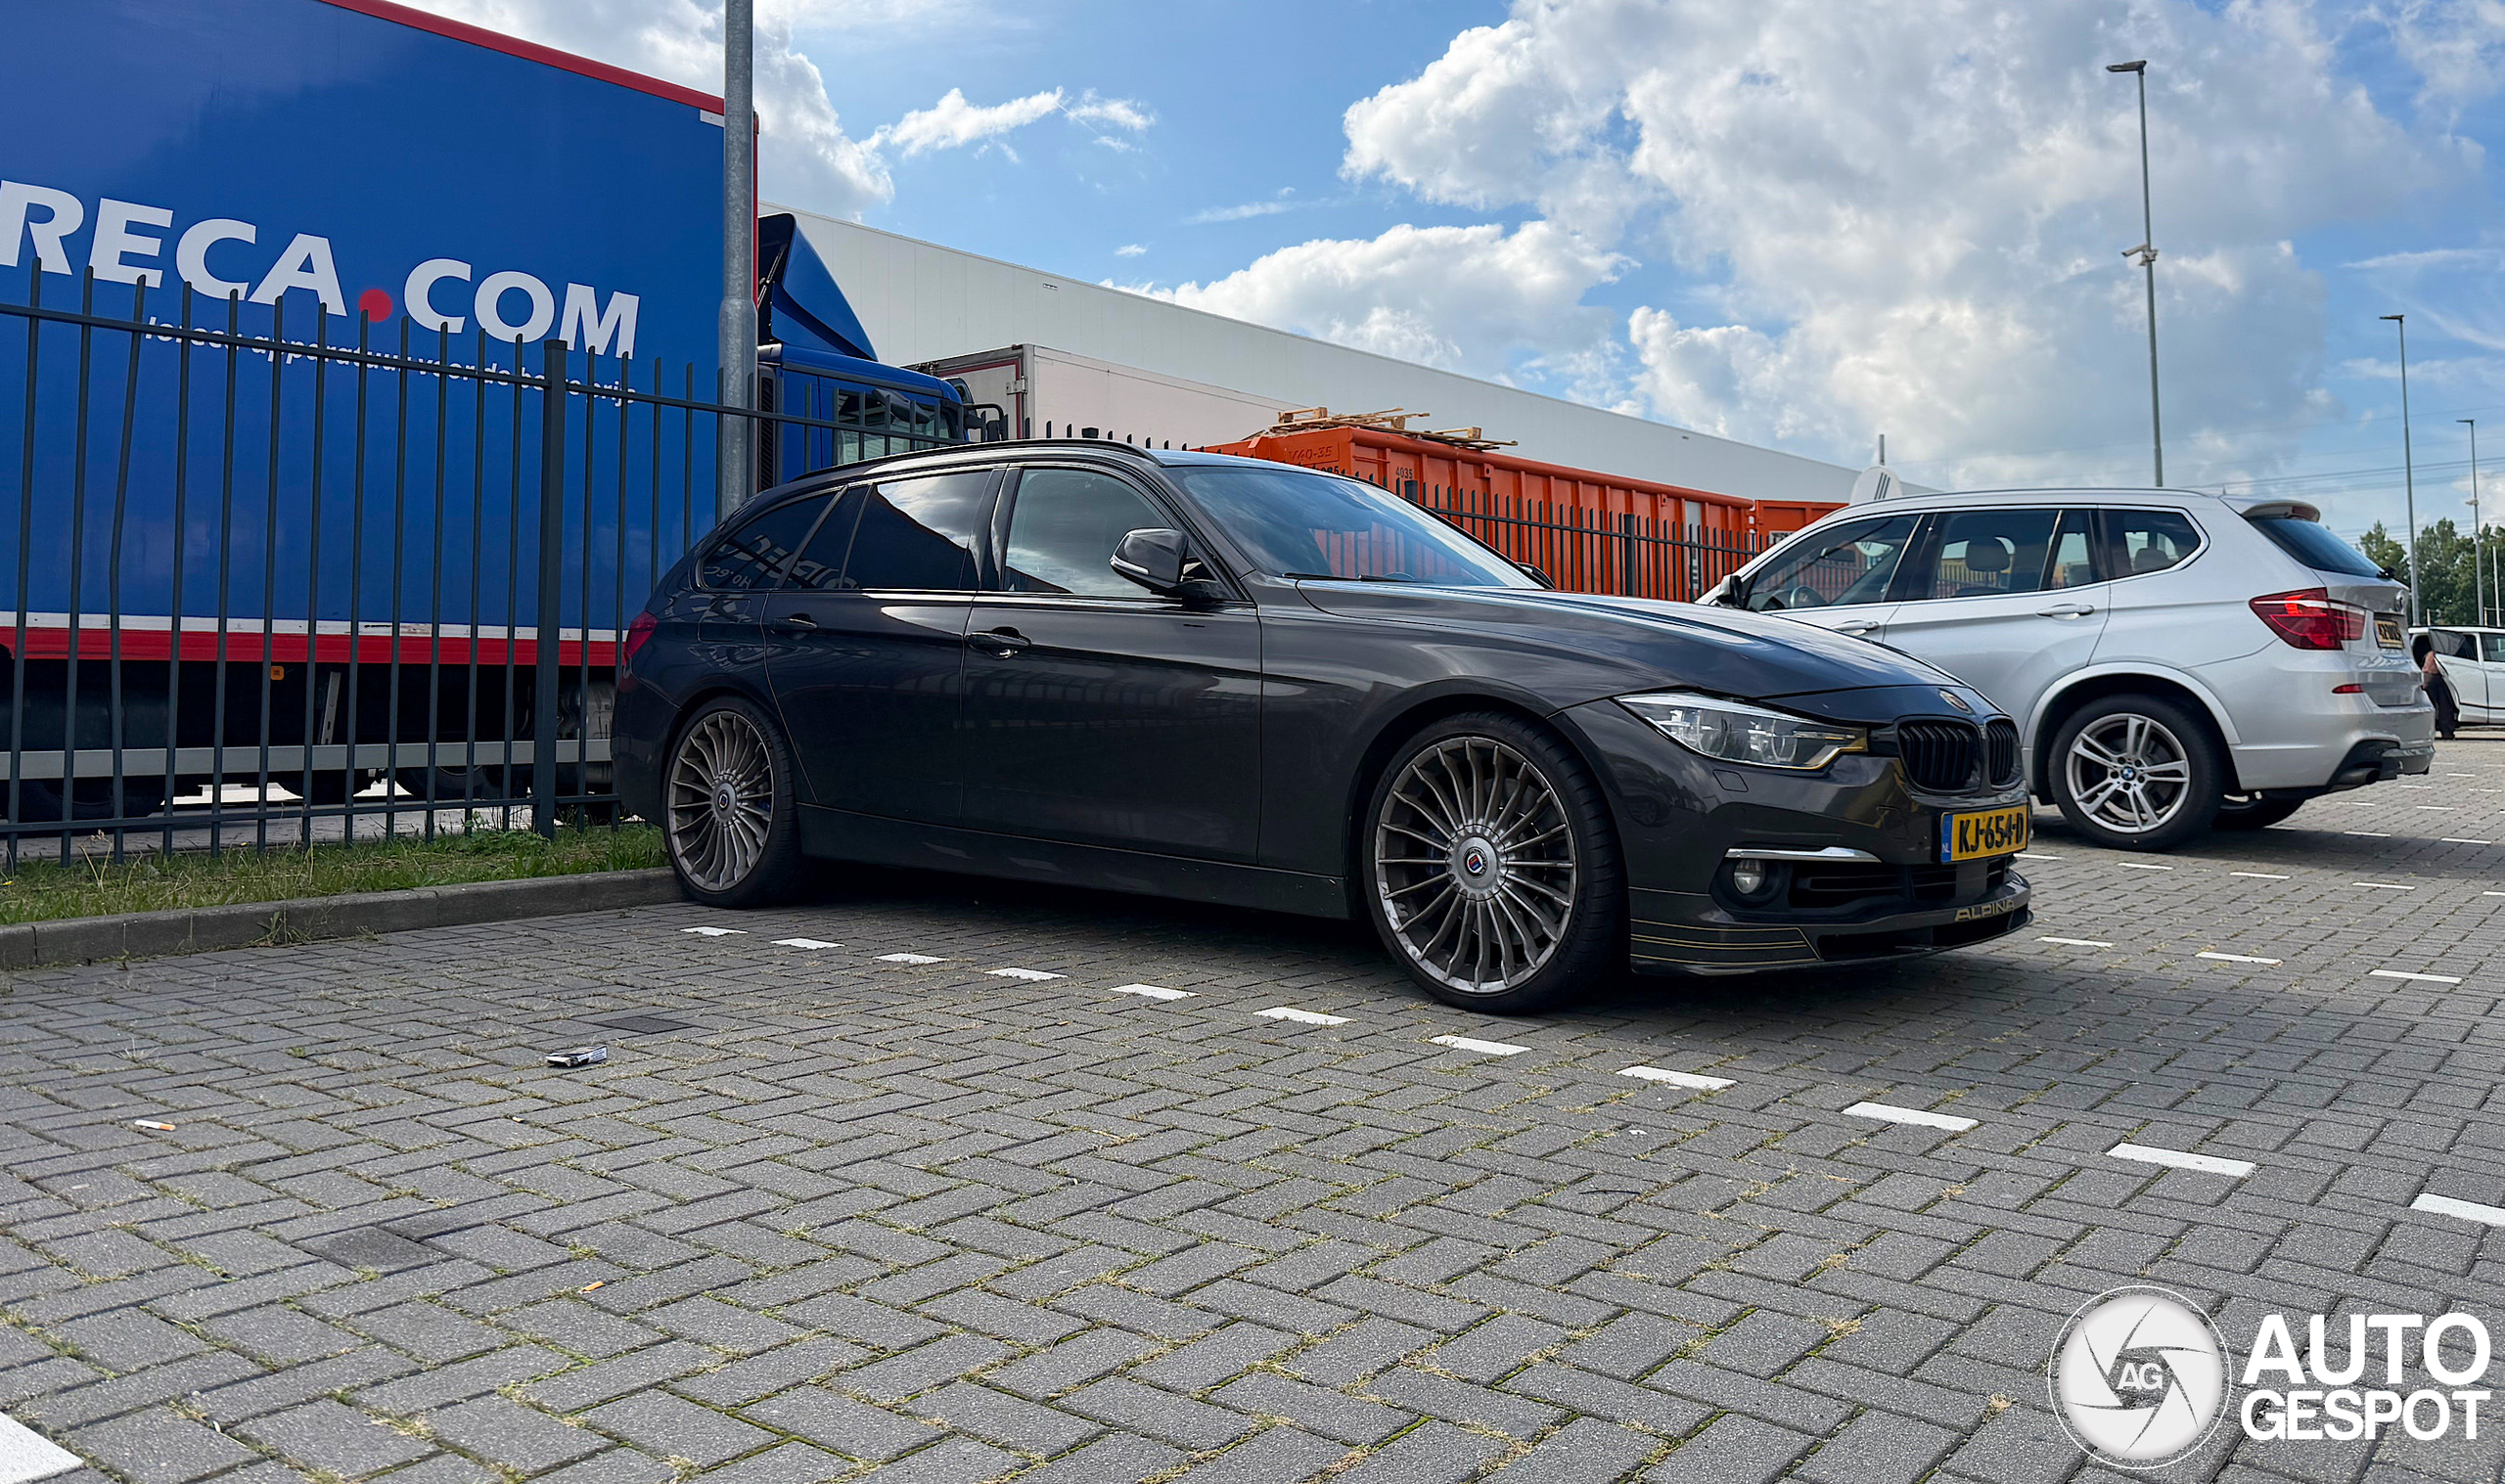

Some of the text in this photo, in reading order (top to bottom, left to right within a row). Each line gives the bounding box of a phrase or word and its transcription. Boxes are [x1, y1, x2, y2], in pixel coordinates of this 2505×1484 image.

[1395, 467, 1413, 479] 4035
[1959, 812, 2025, 854] KJ-654-D
[1955, 899, 2015, 922] ALPINA
